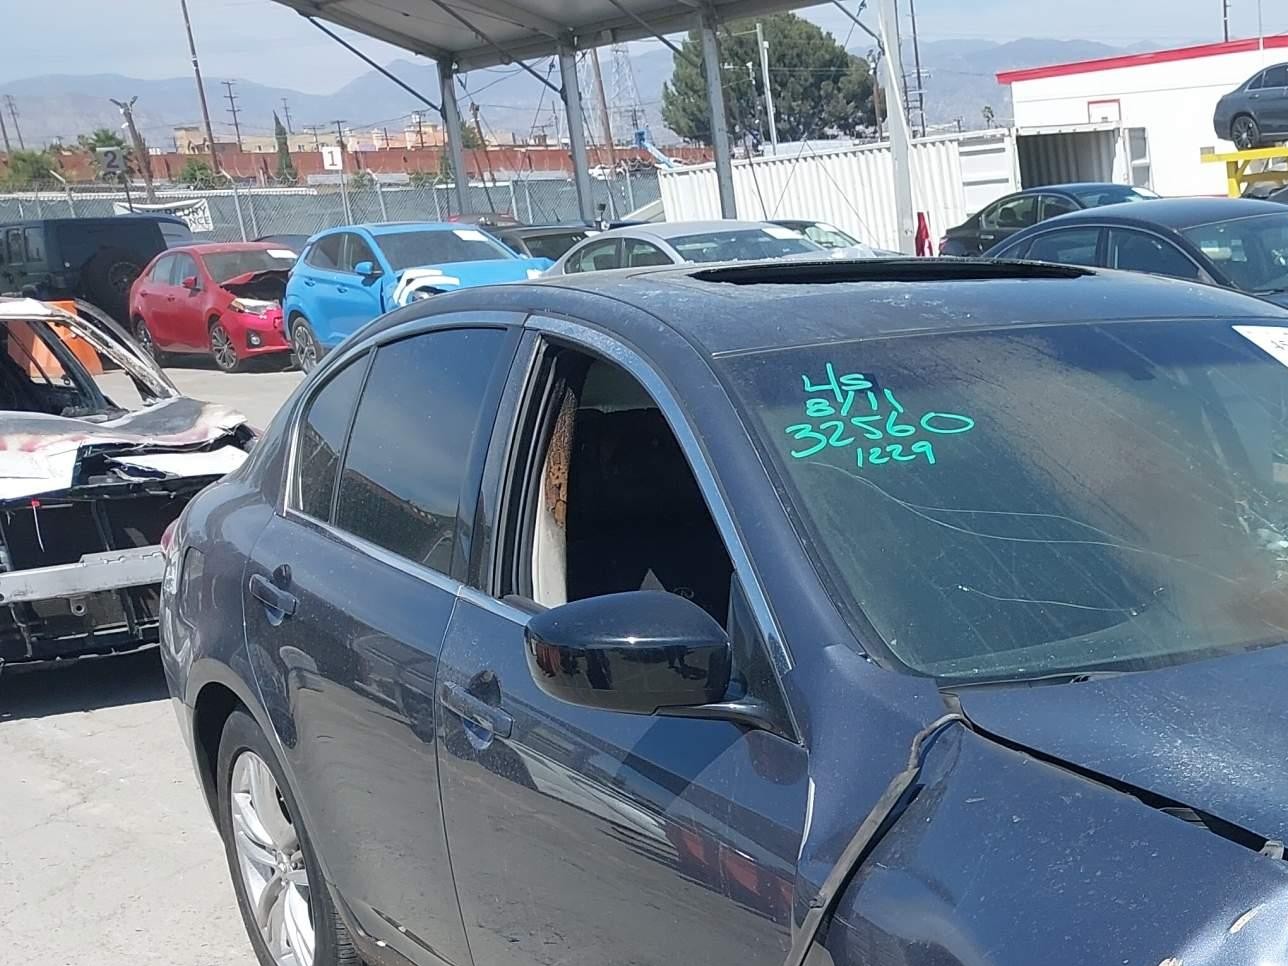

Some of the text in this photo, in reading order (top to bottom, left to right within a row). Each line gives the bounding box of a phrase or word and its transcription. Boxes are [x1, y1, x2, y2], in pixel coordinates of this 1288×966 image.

[104, 150, 119, 168] 2
[328, 151, 338, 166] 1
[785, 411, 975, 459] 32560
[856, 440, 936, 468] 1229
